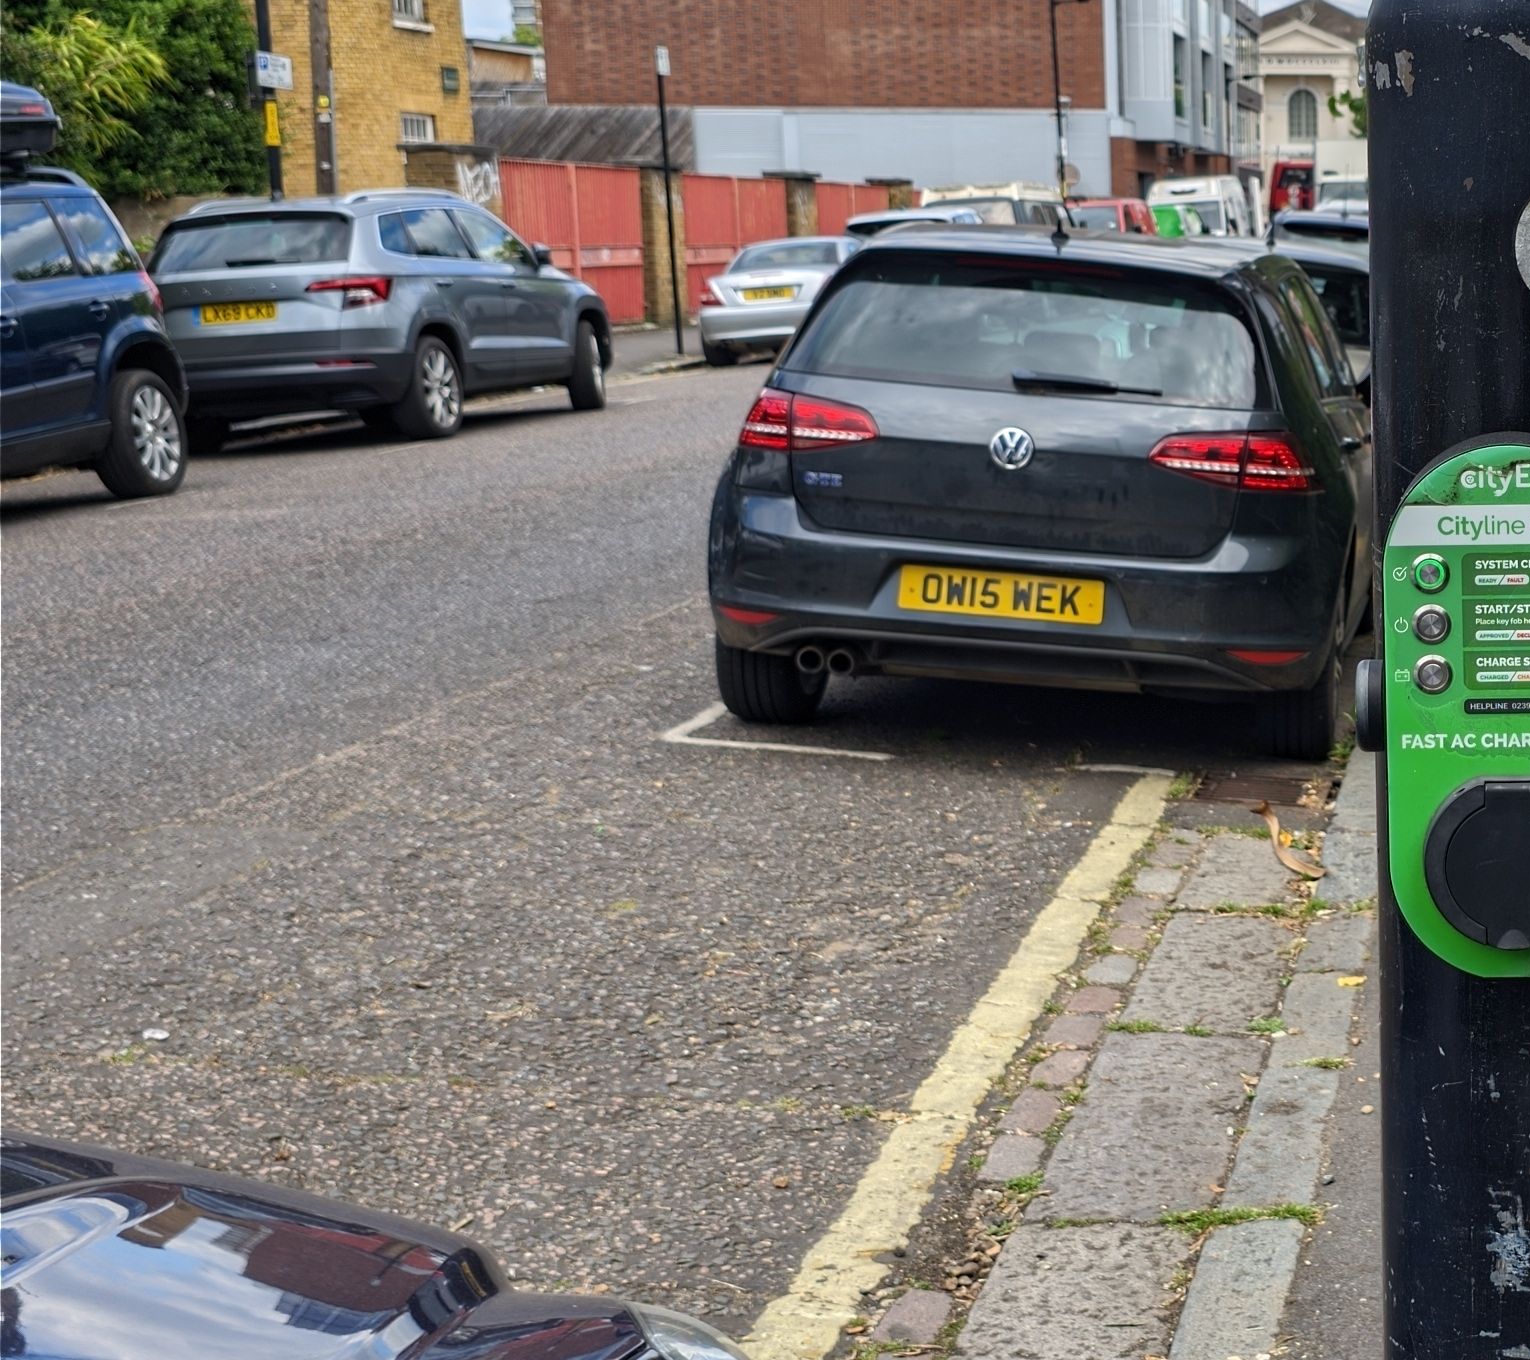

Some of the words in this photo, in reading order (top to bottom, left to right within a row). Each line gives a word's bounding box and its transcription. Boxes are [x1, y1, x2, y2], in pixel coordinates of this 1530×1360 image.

[804, 471, 842, 487] GTE
[1438, 515, 1526, 540] Cityline
[1474, 559, 1518, 569] SYSTEM
[1012, 580, 1082, 616] WEK
[1497, 618, 1509, 626] key
[1476, 657, 1521, 667] CHARGE
[1470, 702, 1508, 710] HELPLINE
[1401, 734, 1447, 748] FAST
[1451, 734, 1476, 748] AC
